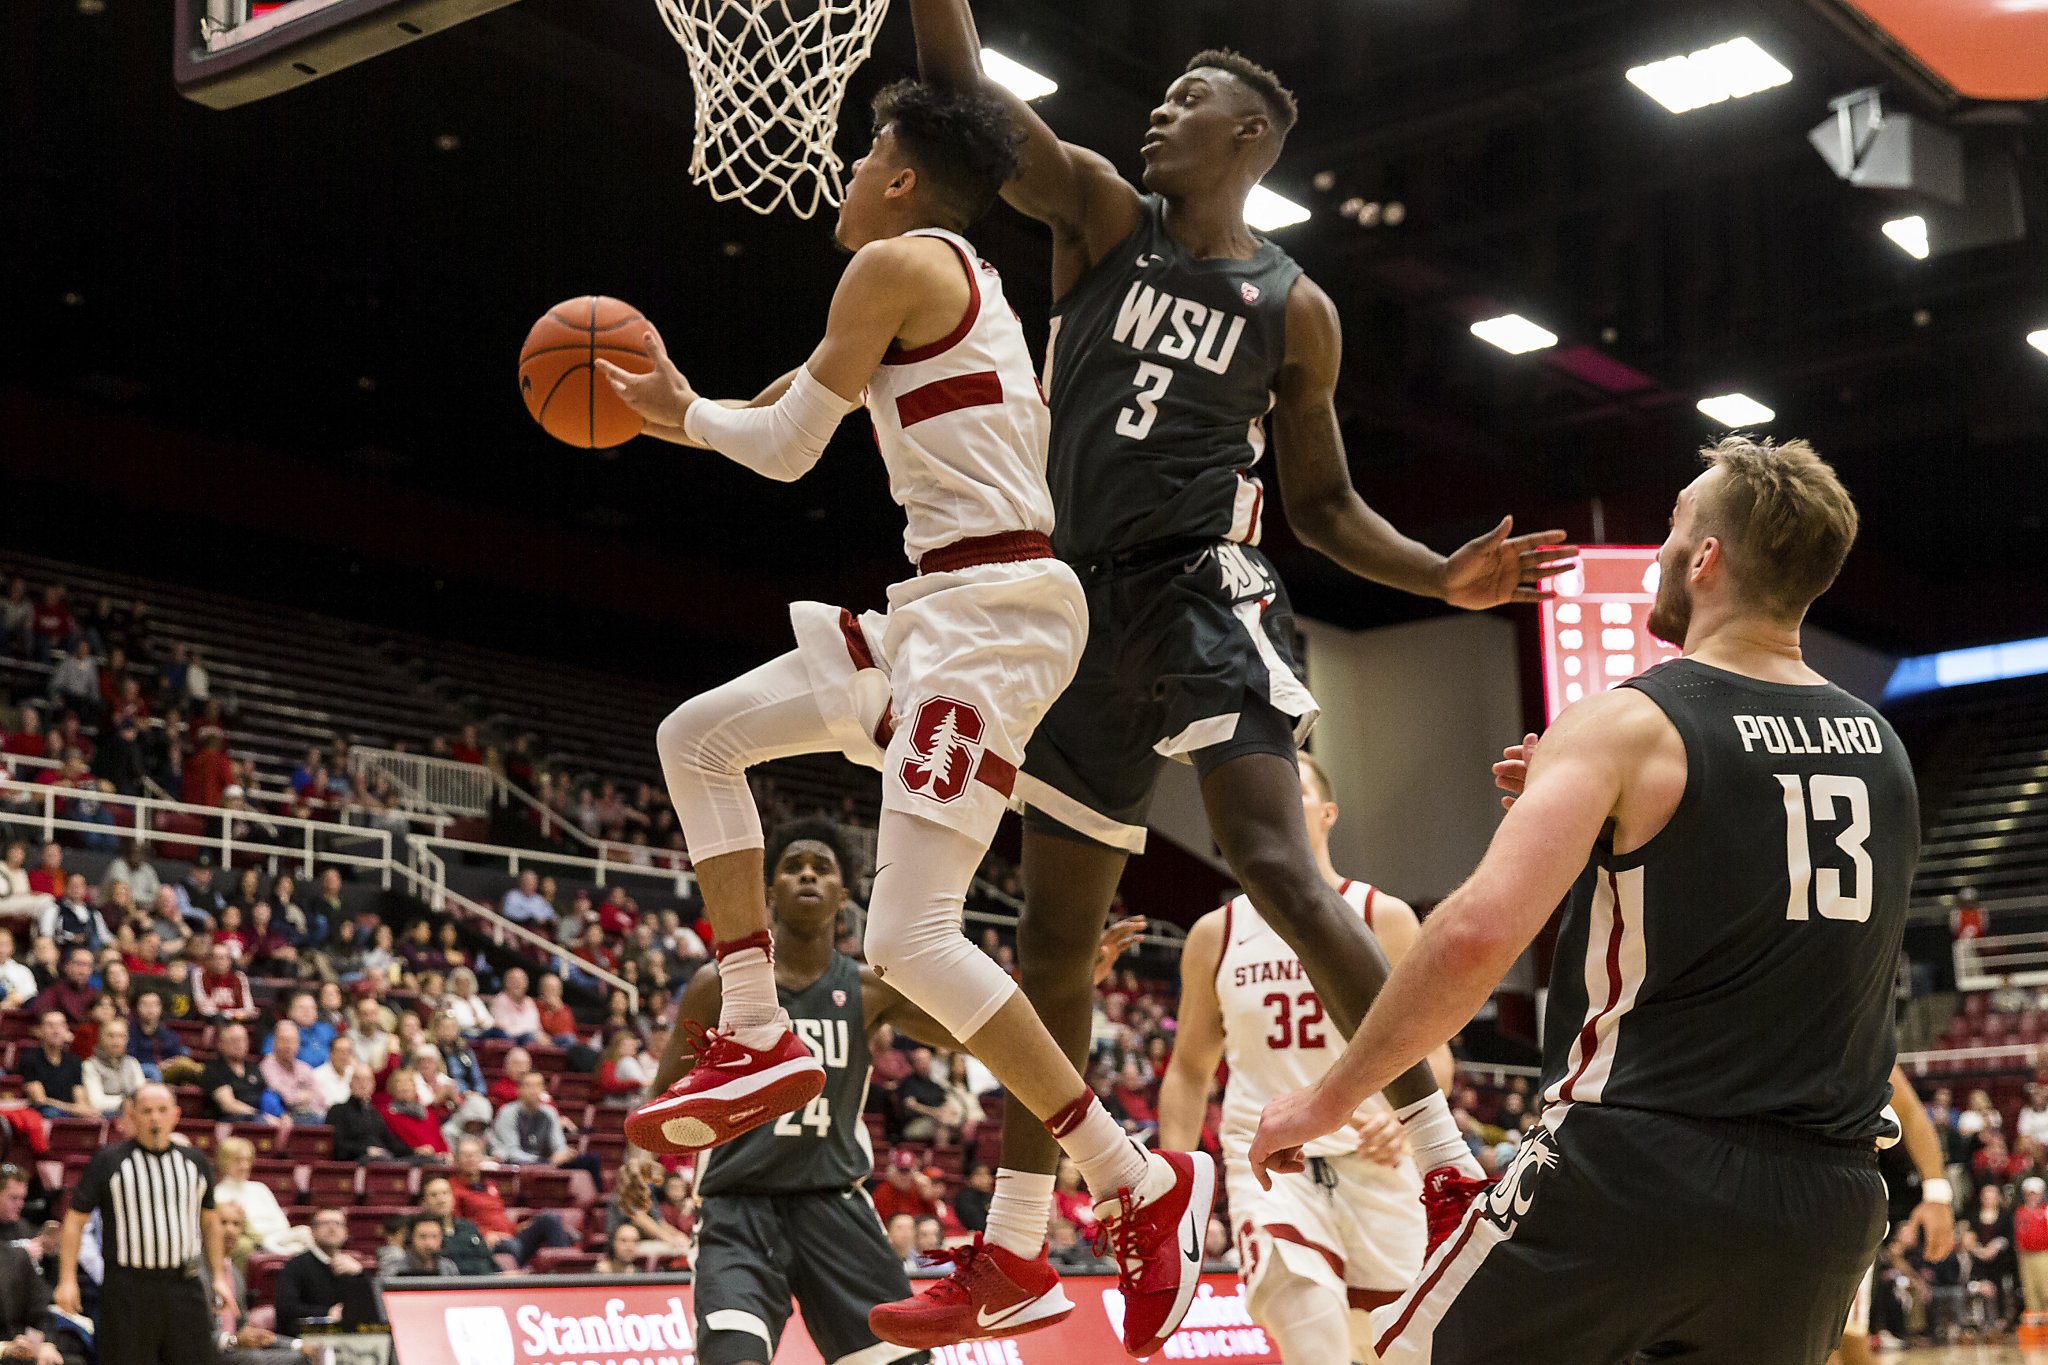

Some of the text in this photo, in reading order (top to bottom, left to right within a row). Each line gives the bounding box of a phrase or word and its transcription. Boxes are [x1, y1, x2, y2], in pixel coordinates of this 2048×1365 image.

[1112, 279, 1247, 376] WSU
[1114, 360, 1174, 441] 3
[1732, 715, 1883, 754] POLLARD
[1772, 774, 1873, 923] 13
[788, 1018, 849, 1068] SU
[1263, 991, 1326, 1050] 32
[516, 1297, 694, 1357] Stanford
